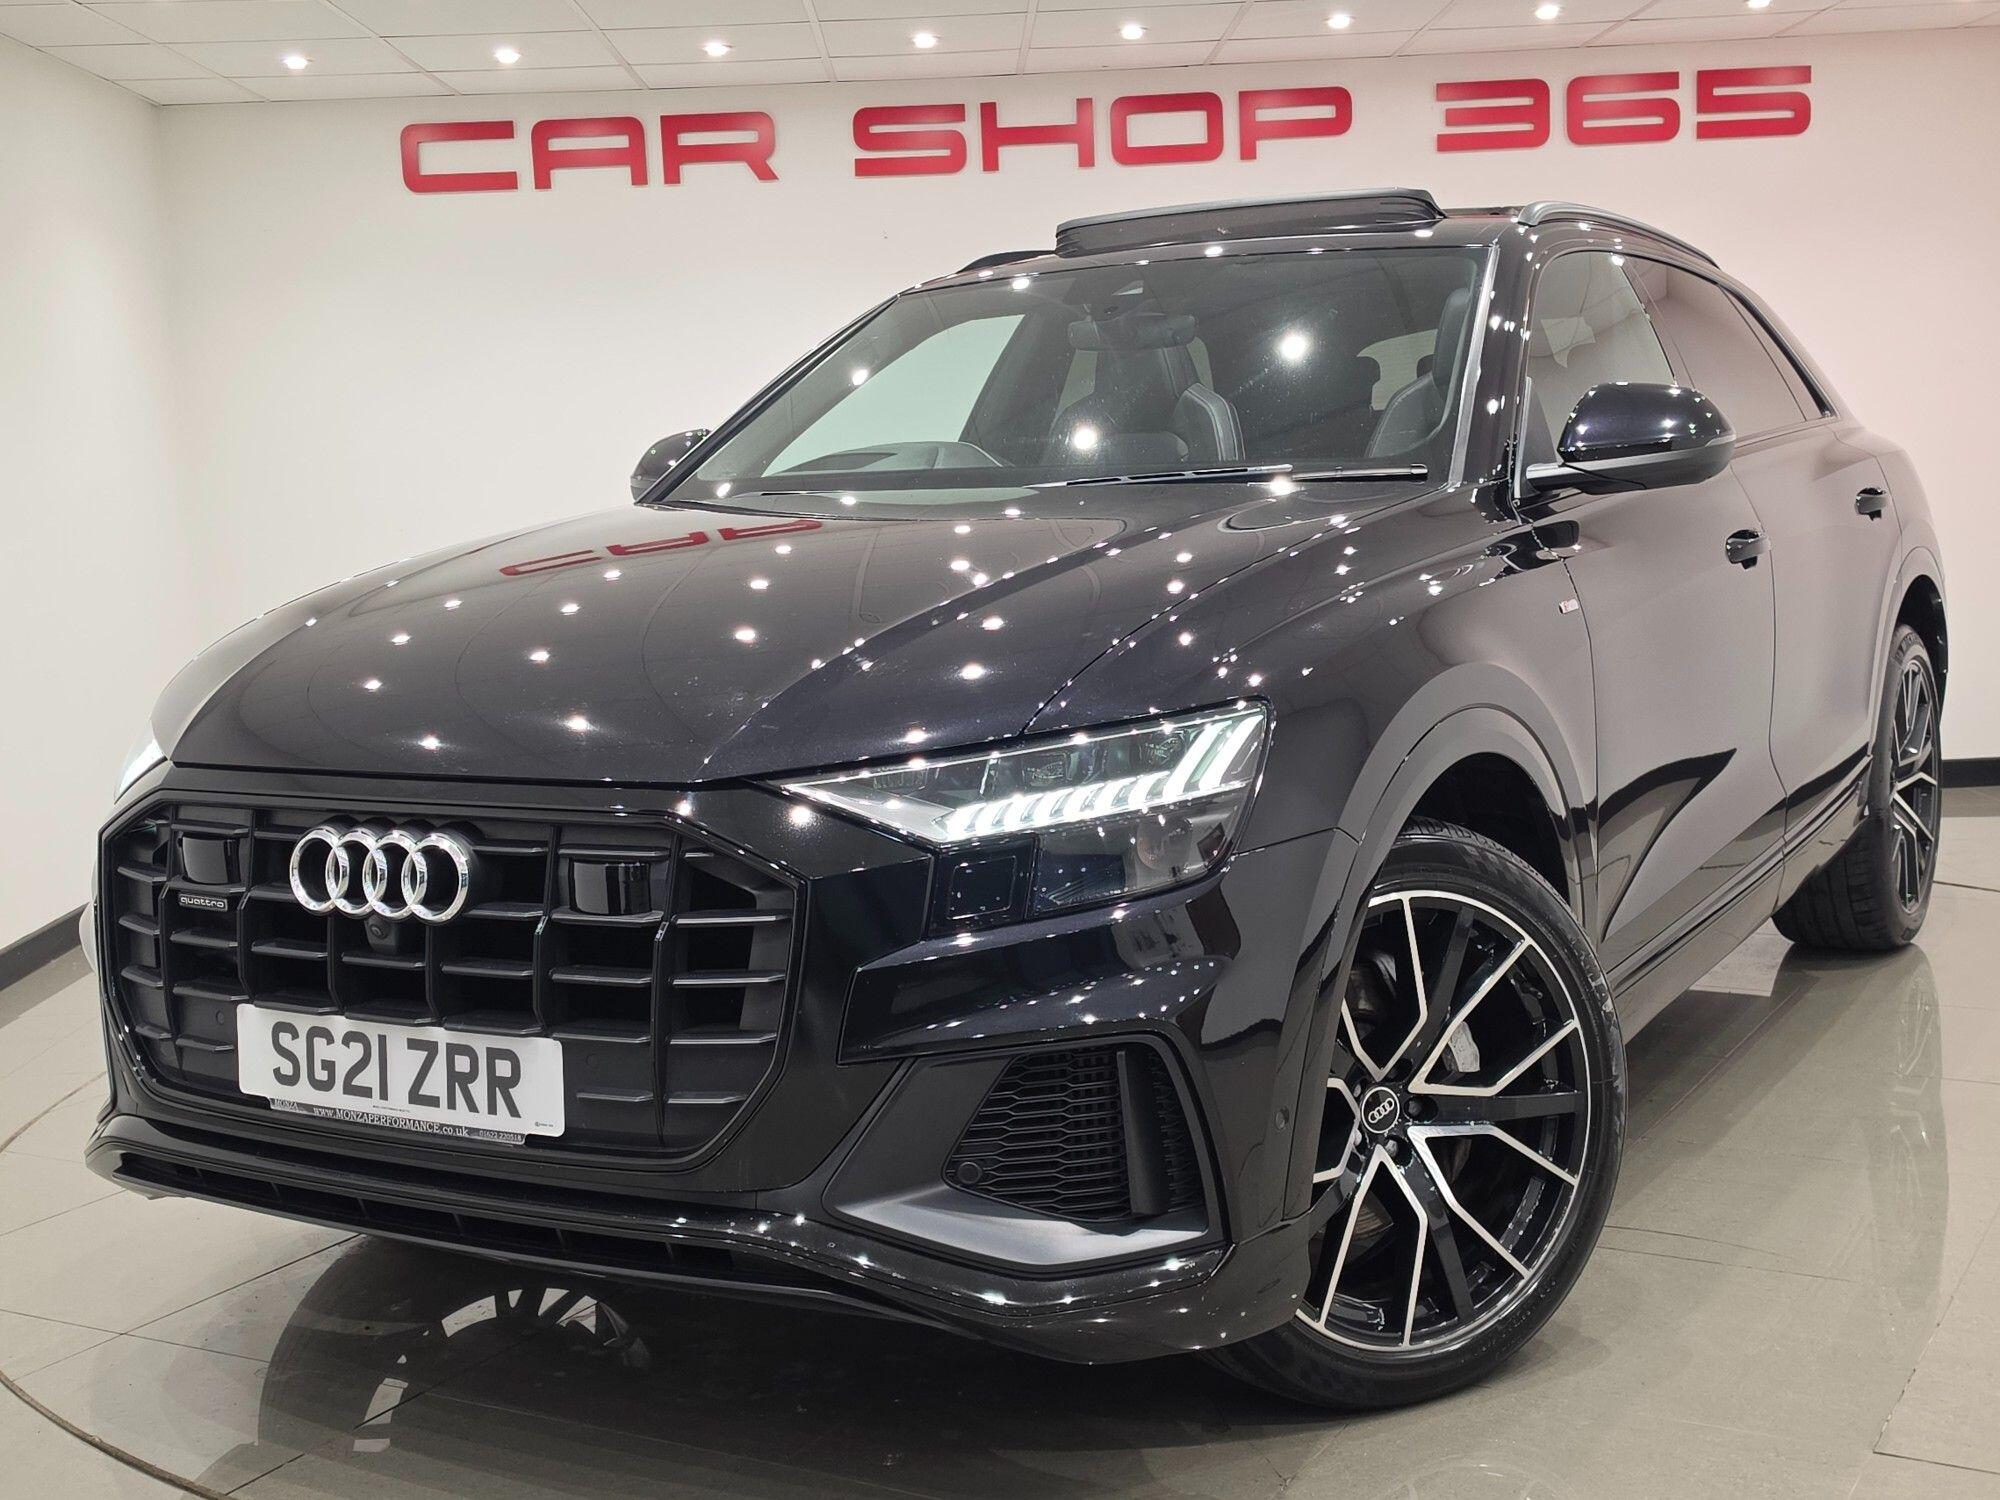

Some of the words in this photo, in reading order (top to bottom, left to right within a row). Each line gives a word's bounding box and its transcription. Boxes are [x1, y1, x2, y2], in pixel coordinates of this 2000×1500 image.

[400, 111, 779, 193] CAR
[852, 86, 1353, 177] SHOP
[1435, 65, 1812, 152] 365
[180, 896, 225, 908] quattro
[271, 1021, 389, 1101] SG21
[406, 1037, 522, 1118] ZRR
[313, 1106, 470, 1137] www.MONZAPERFORMANCE.co.uk
